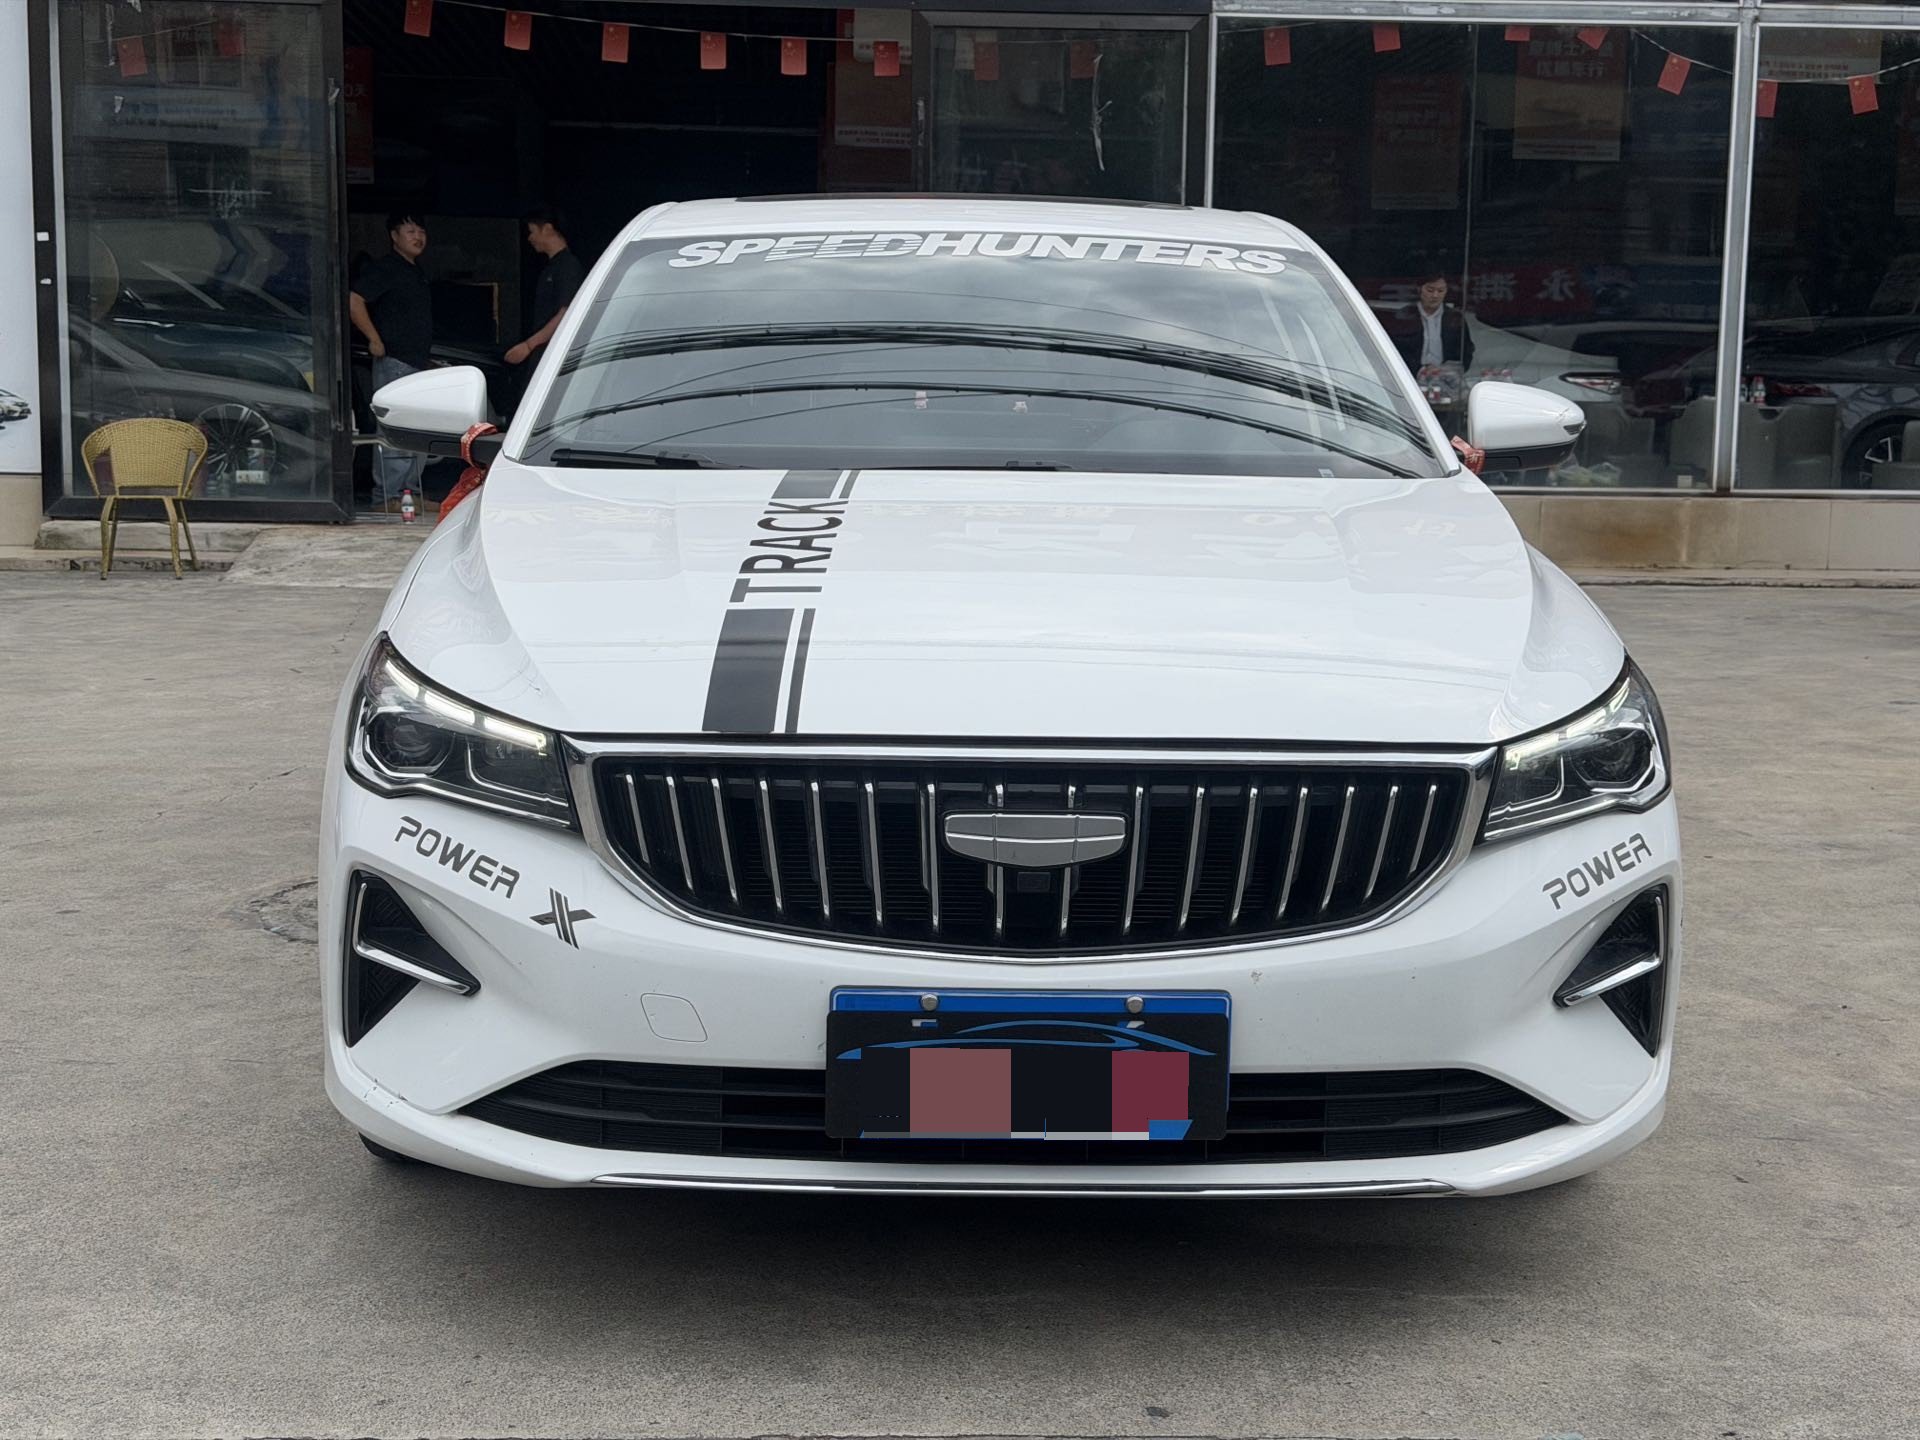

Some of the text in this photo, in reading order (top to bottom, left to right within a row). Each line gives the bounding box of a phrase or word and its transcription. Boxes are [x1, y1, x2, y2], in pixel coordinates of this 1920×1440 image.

[668, 231, 1288, 275] SPEEDHUNTERS
[729, 500, 849, 603] TRACK
[394, 815, 520, 899] POWER
[1542, 832, 1652, 910] POWER
